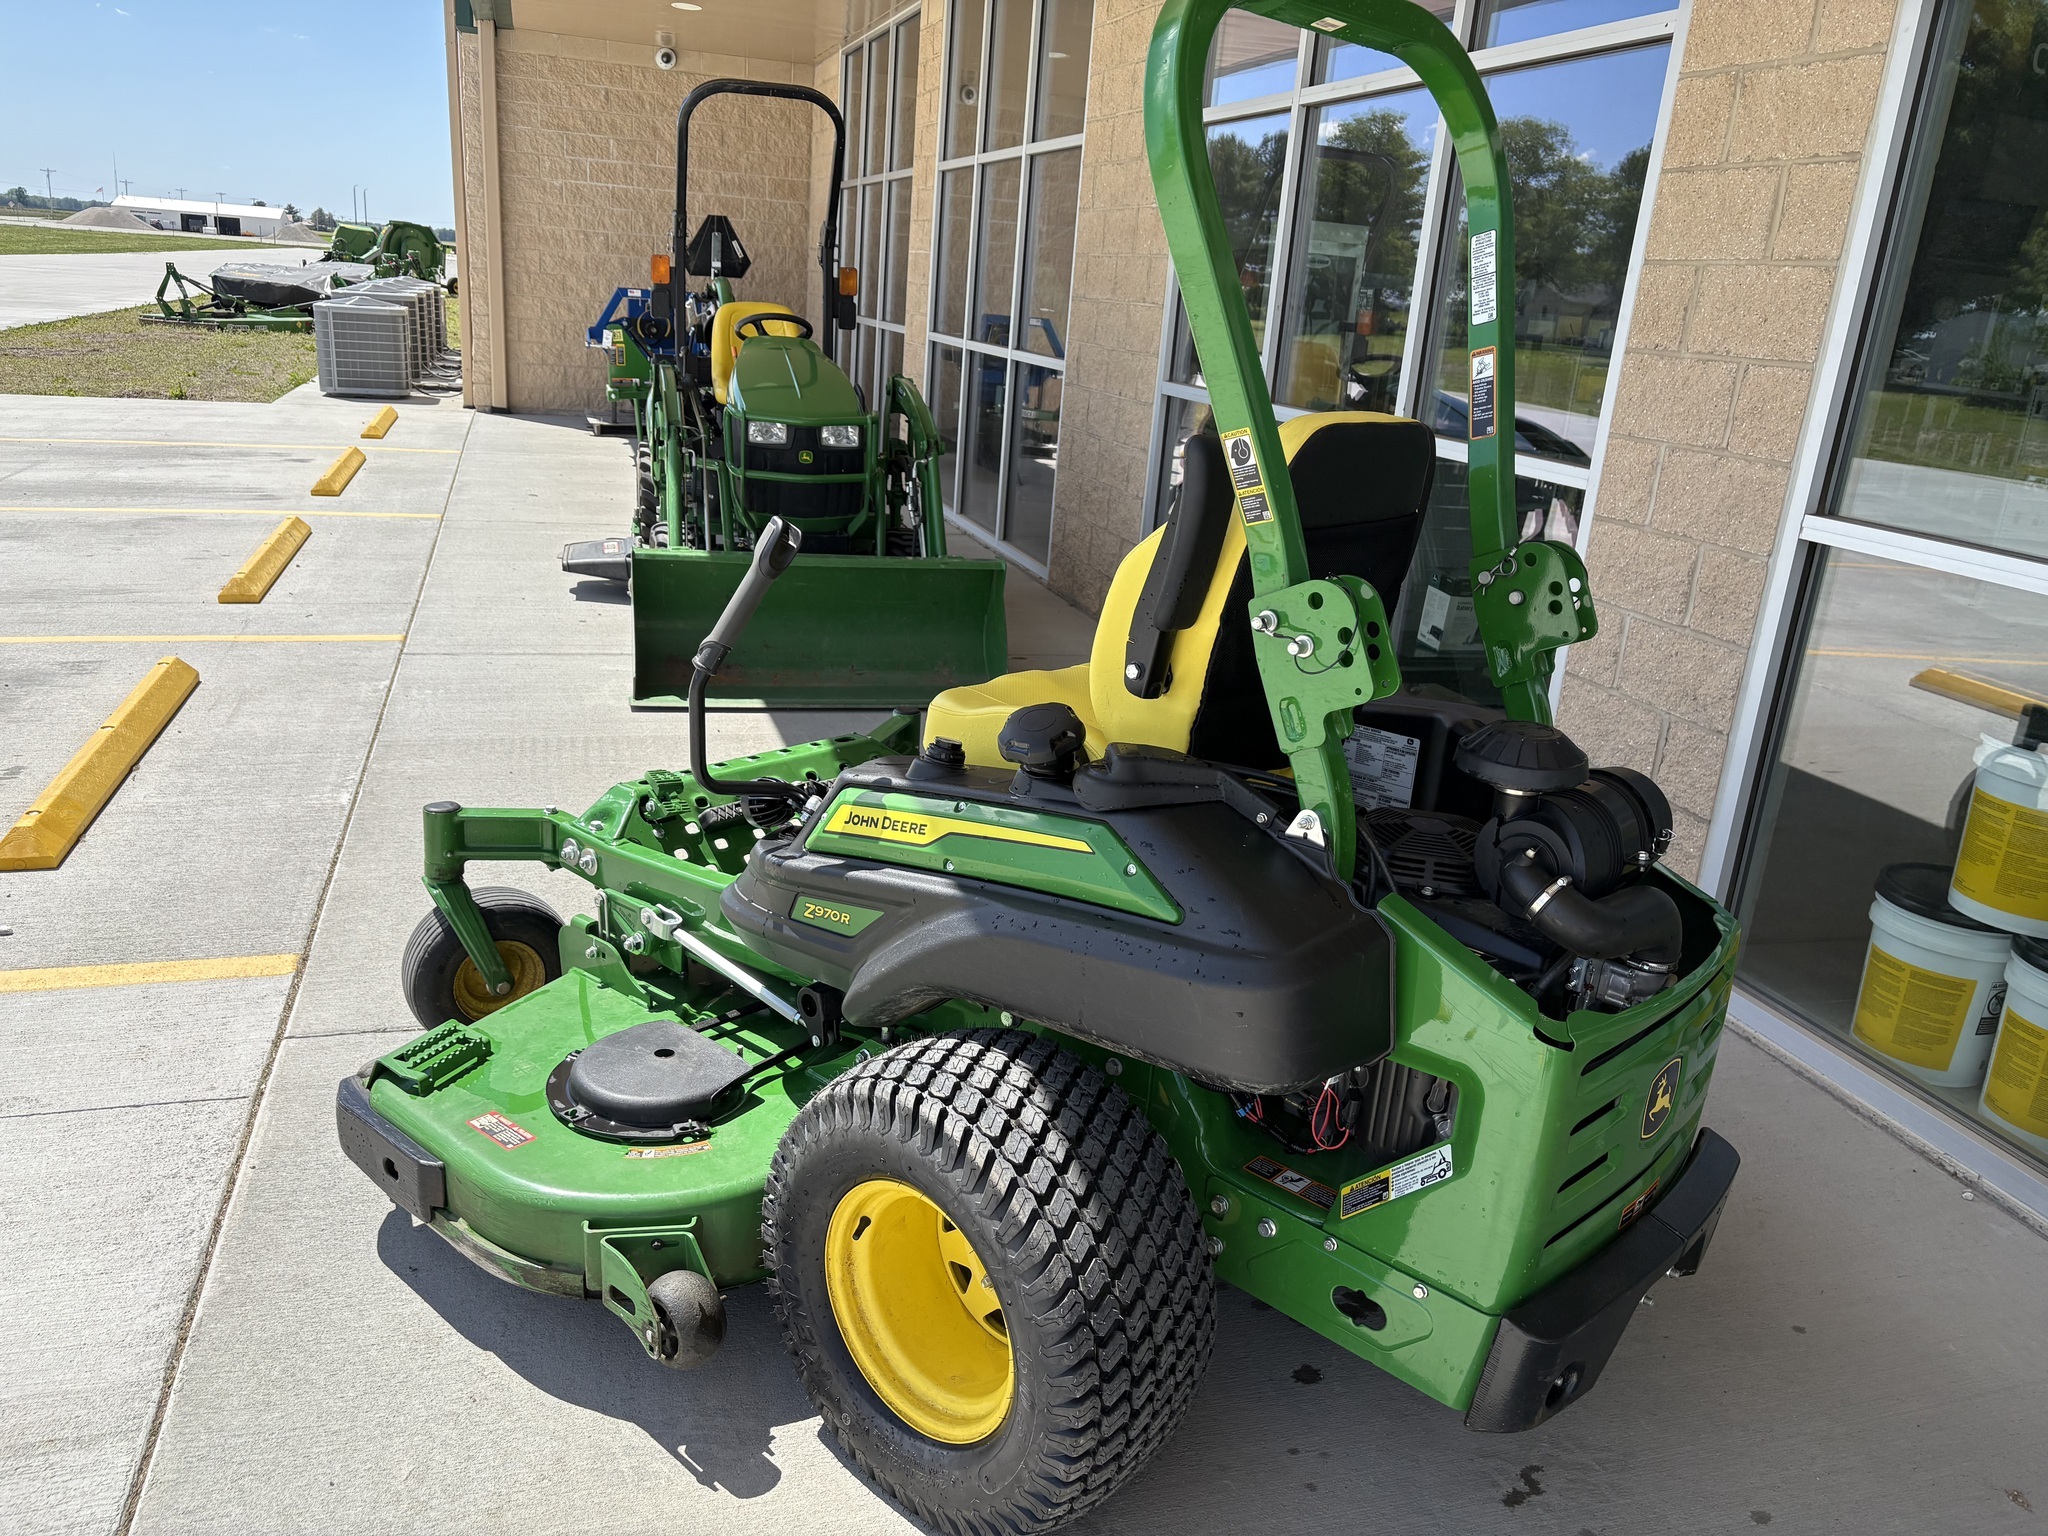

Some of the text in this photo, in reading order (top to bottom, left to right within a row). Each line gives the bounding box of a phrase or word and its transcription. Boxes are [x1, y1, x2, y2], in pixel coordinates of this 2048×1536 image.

[1227, 428, 1248, 438] CAUTION
[844, 811, 927, 836] JOHN DEERE
[803, 902, 851, 925] Z970R
[1355, 1174, 1382, 1189] ATENCIÓN
